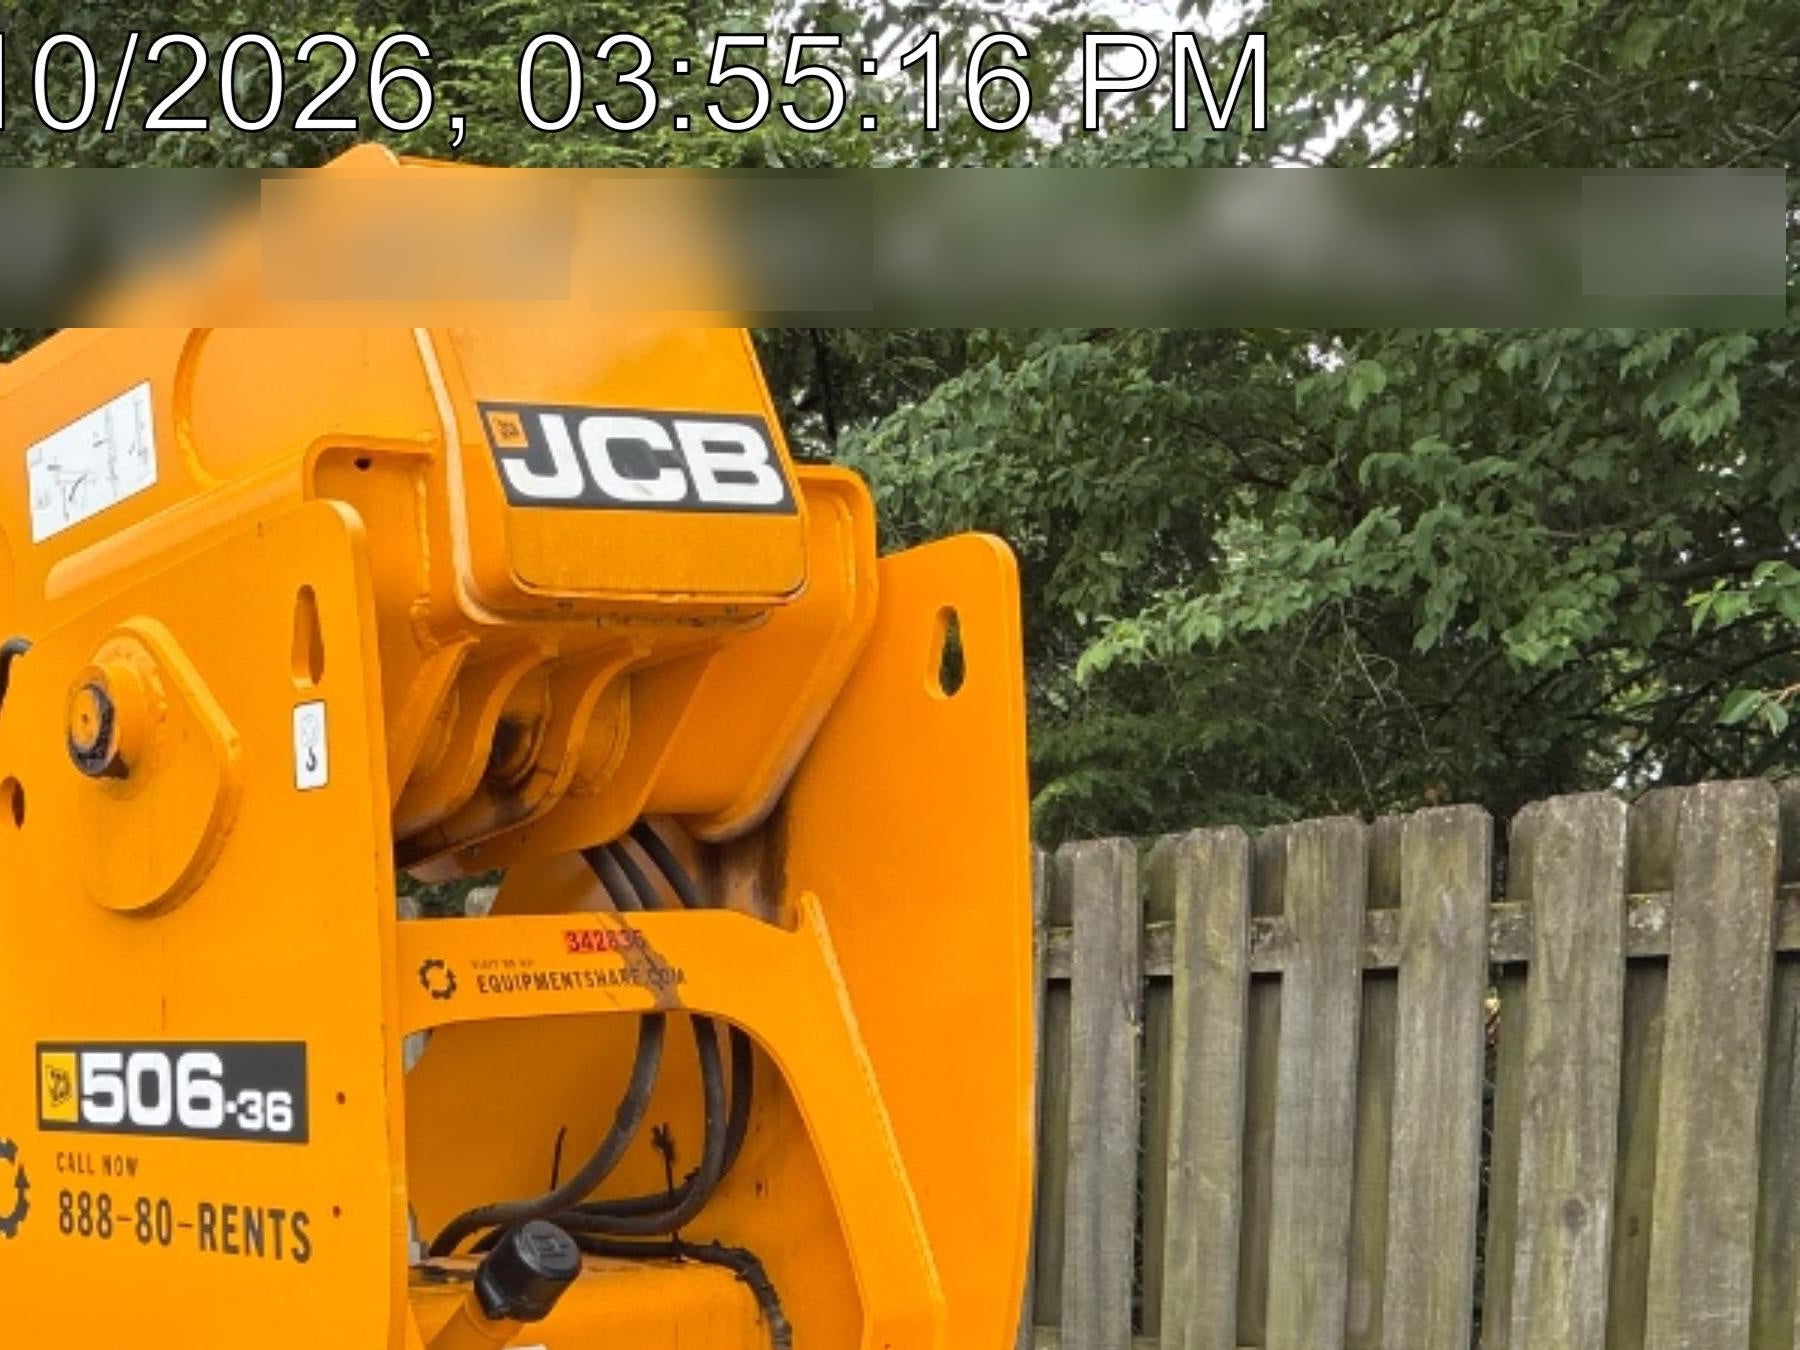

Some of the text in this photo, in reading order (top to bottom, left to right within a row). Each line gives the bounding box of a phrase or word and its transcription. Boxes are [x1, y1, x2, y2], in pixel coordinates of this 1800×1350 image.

[501, 413, 784, 504] JCB
[56, 1151, 139, 1178] CALL NOW
[59, 1189, 311, 1264] 888-80-RENTS
